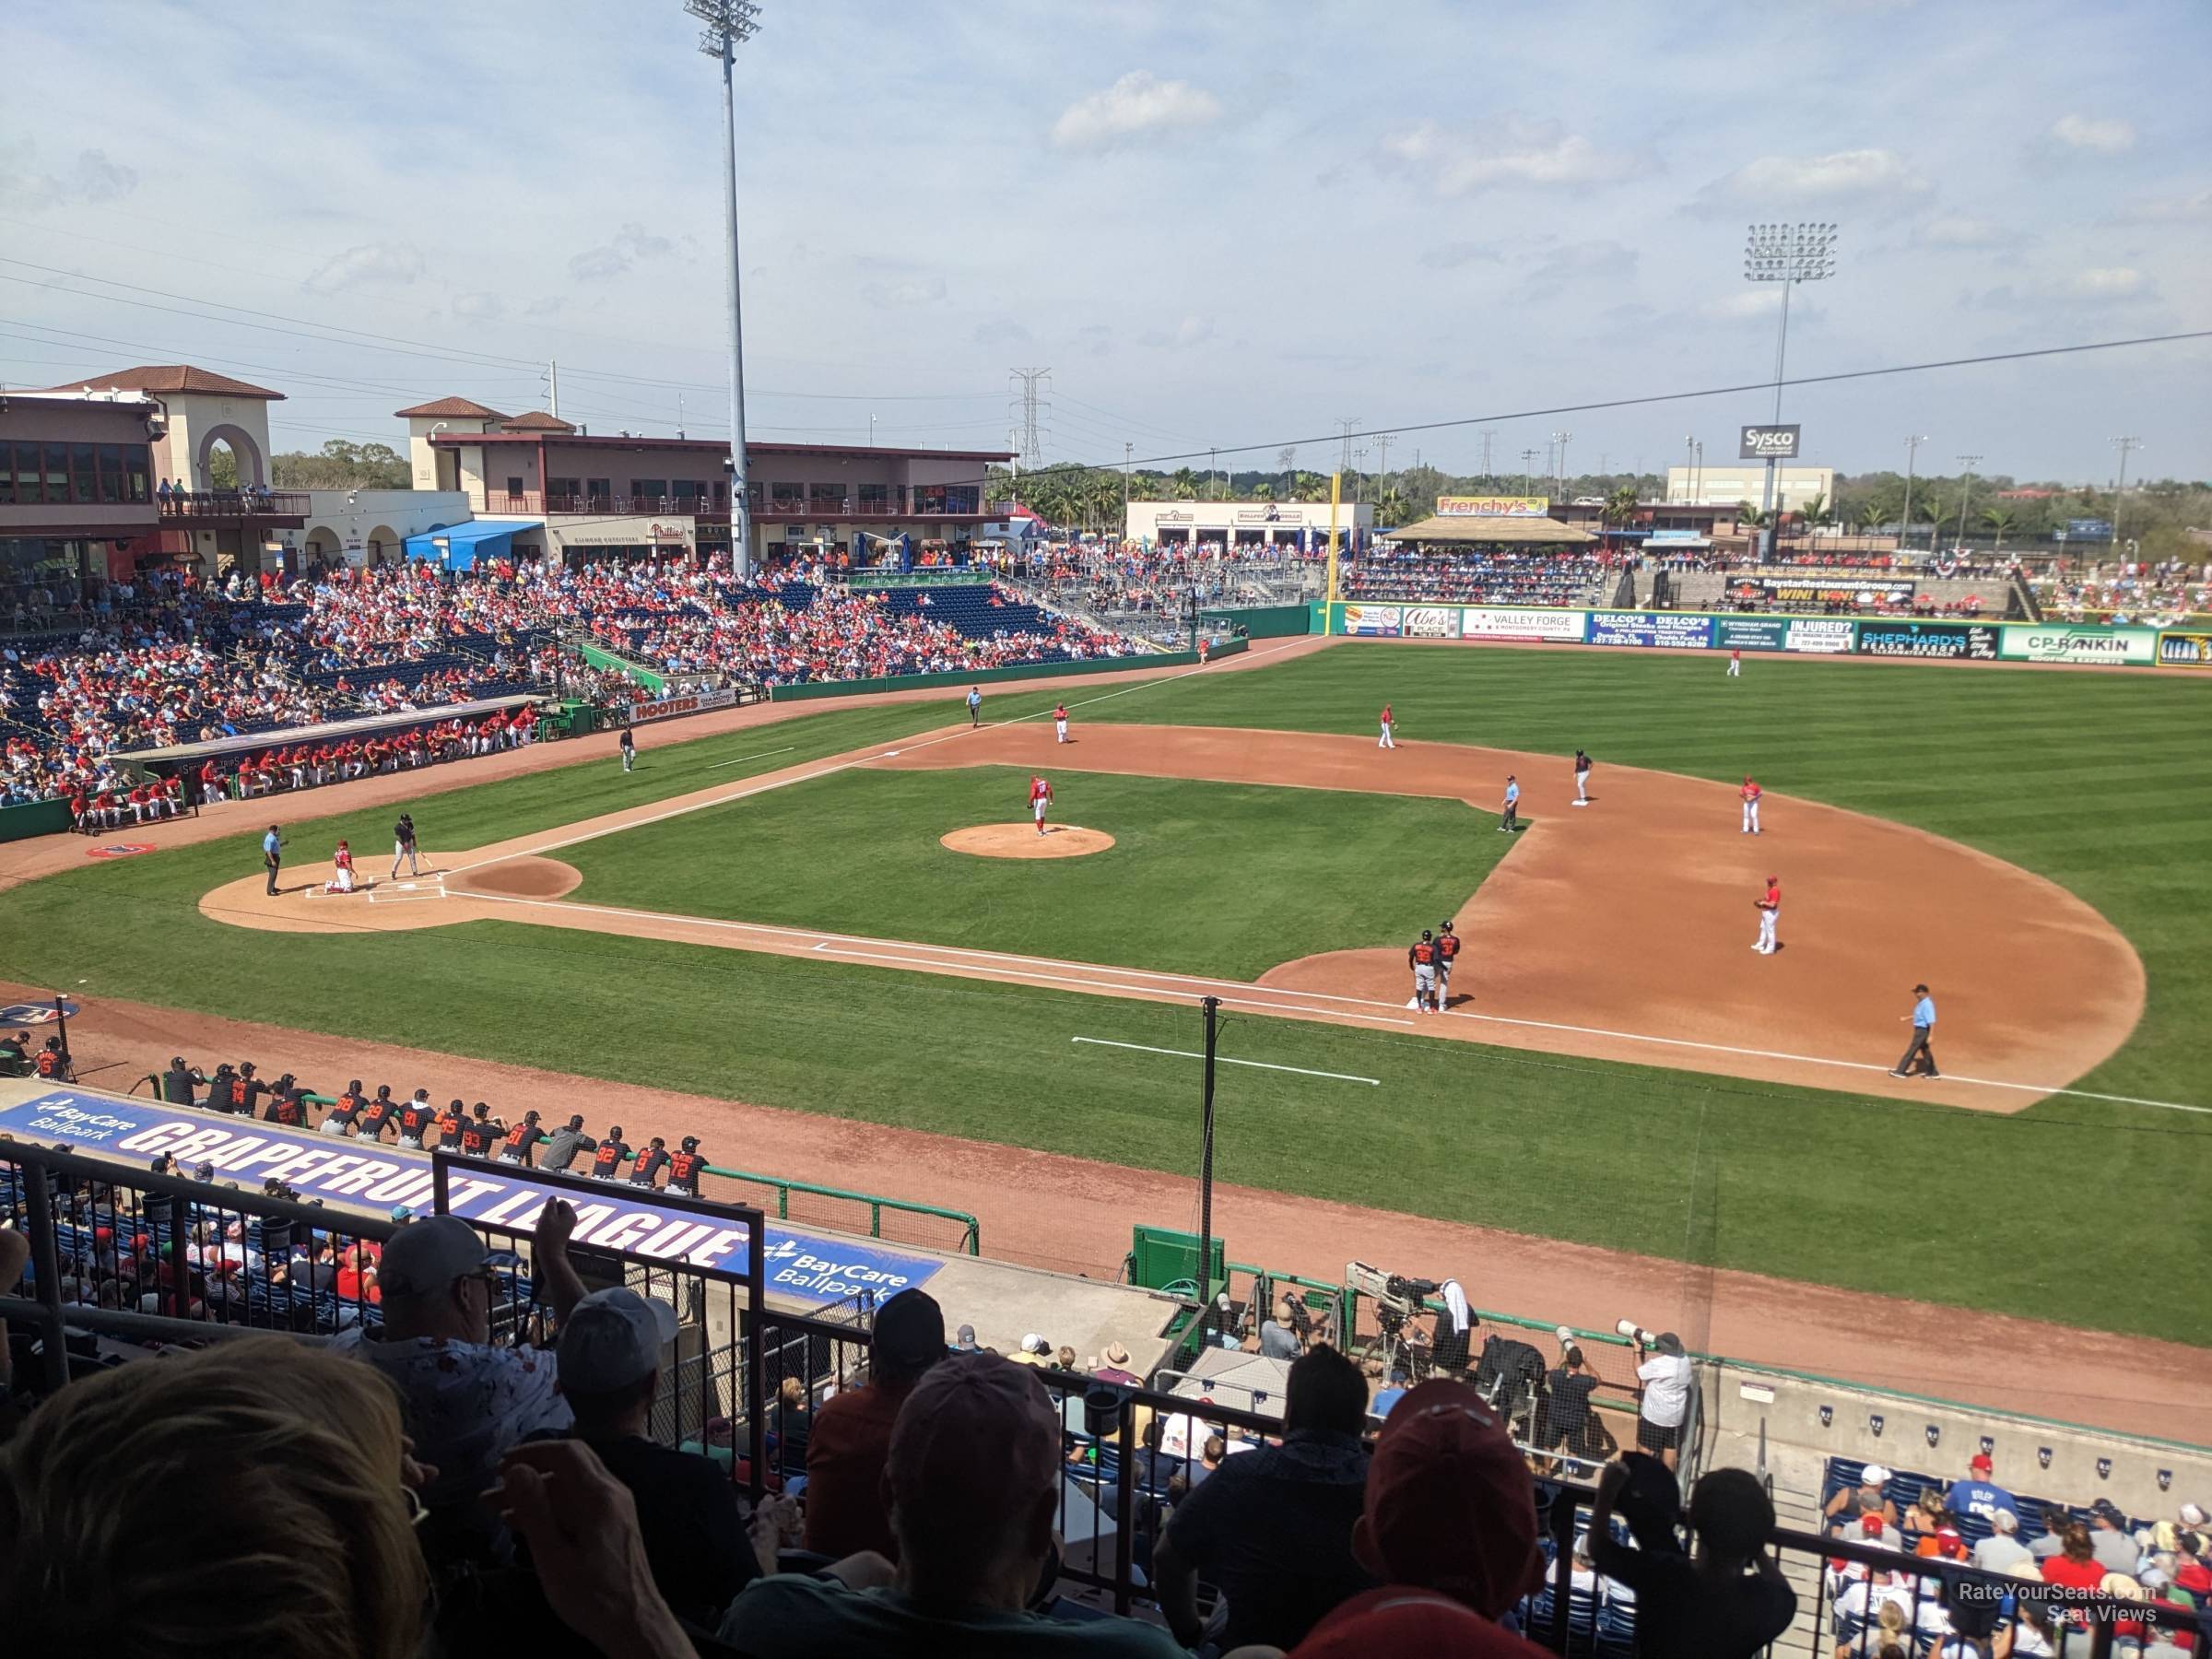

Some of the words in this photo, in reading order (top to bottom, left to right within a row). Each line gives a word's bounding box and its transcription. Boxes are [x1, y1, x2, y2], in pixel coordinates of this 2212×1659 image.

[1746, 429, 1794, 450] Sysco
[1440, 498, 1527, 516] Frenchy's
[651, 524, 684, 537] Phillies
[1763, 579, 1912, 591] BaystarRestaurantGroup.com
[1777, 589, 1815, 600] WIN!
[1406, 608, 1446, 625] Abe's
[1494, 615, 1534, 625] VALLEY
[1536, 617, 1571, 626] FORGE
[1593, 615, 1645, 624] DELCO'S
[1656, 616, 1710, 626] DELCO'S
[1790, 620, 1853, 633] INJURED?
[1862, 633, 1966, 646] SHEPHARD'S
[1861, 642, 1904, 651] BEACH
[1913, 643, 1965, 653] RESORT
[2160, 640, 2200, 660] CLEAR
[700, 694, 733, 702] DIAMOND
[702, 699, 730, 708] DUGOUT
[636, 697, 699, 719] HOOTERS
[54, 1104, 137, 1131] BayCare
[28, 1117, 113, 1141] Ballpark
[507, 1130, 524, 1146] 81
[636, 1157, 647, 1171] 9
[671, 1161, 689, 1179] 72
[792, 1254, 908, 1288] BayCare
